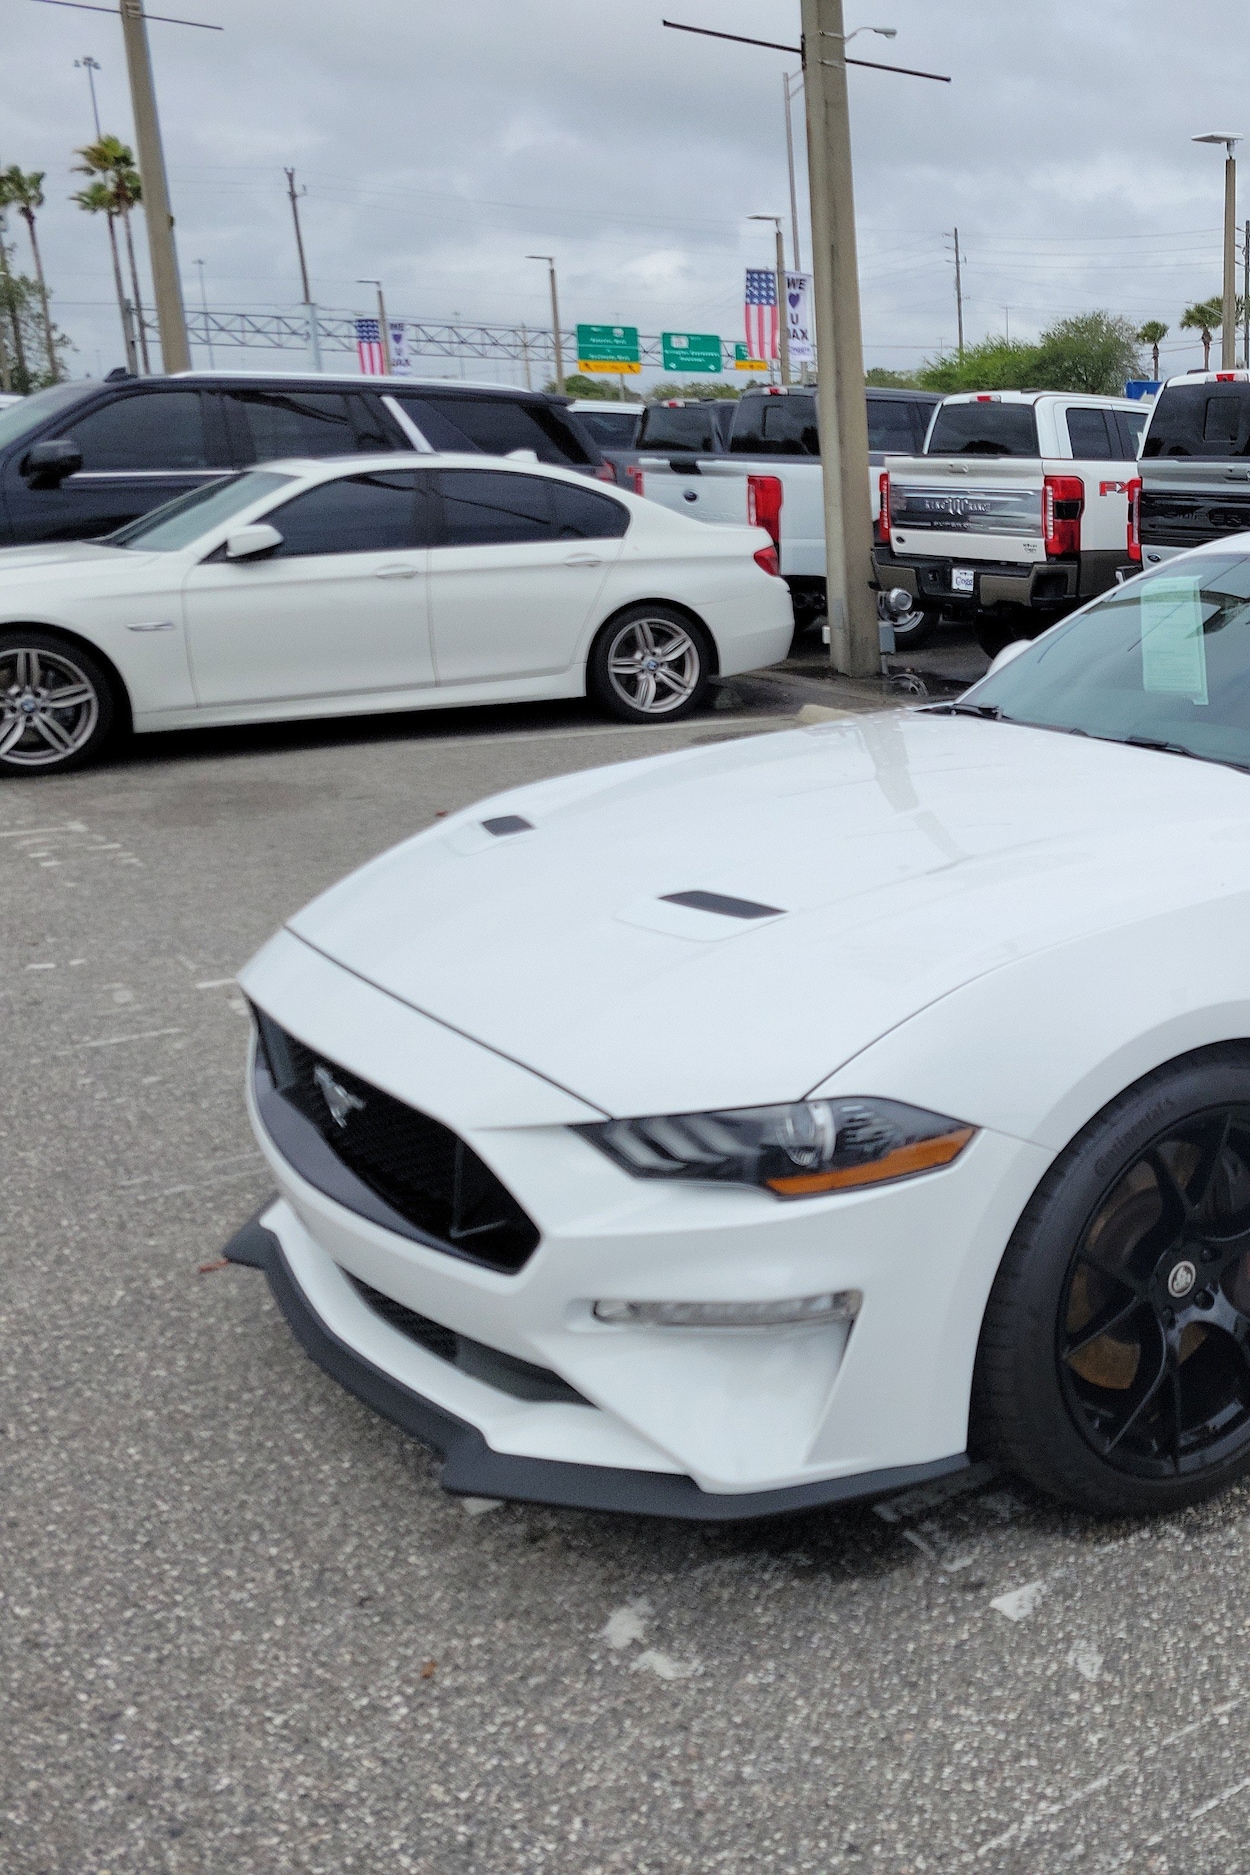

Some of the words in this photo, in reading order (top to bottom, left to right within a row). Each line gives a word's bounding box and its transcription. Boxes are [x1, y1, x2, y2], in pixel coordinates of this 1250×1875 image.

[787, 277, 807, 291] WE
[790, 312, 799, 325] U
[1100, 481, 1129, 496] FX
